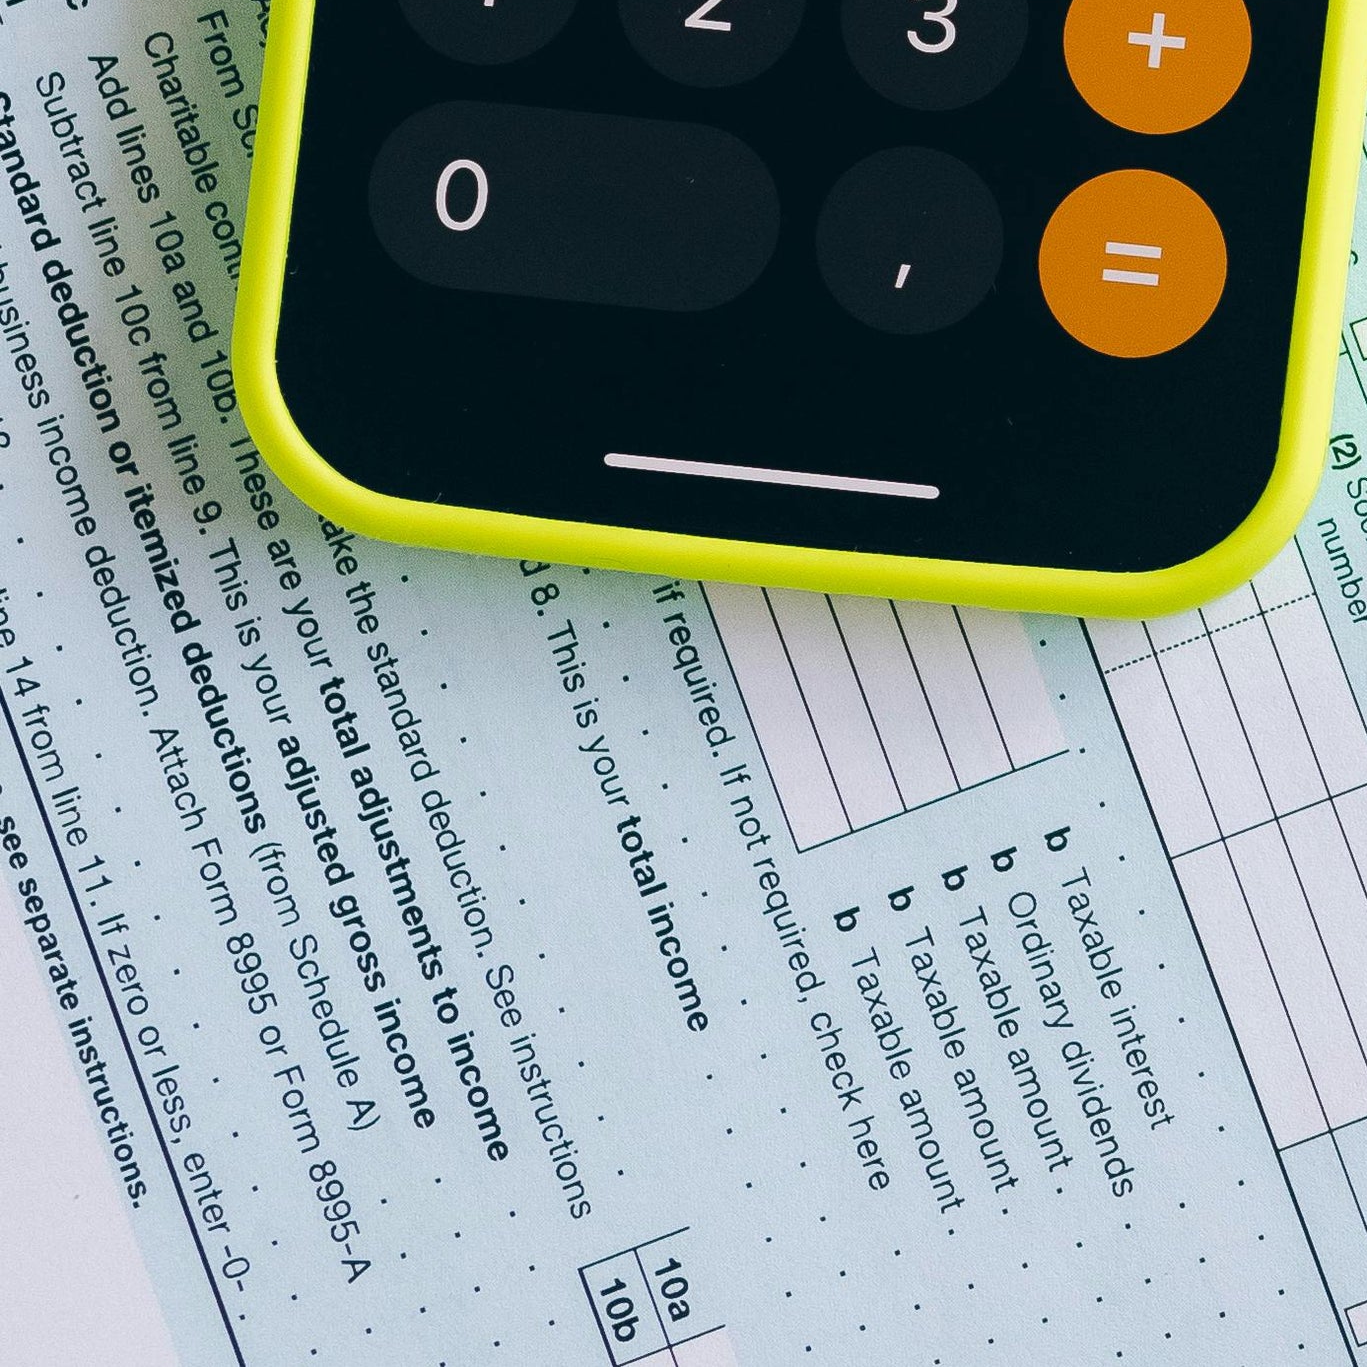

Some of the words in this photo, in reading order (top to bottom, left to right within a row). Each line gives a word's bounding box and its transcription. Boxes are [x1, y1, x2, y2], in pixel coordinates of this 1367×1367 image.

[35, 71, 107, 213] Subtract
[435, 159, 489, 232] 0
[86, 215, 126, 277] line
[114, 283, 151, 347] 10c
[137, 350, 182, 431] from
[166, 433, 205, 495] line
[1327, 433, 1362, 470] (2)
[192, 499, 222, 535] 9.
[208, 535, 248, 611] This
[233, 615, 262, 647] is
[546, 618, 586, 692] This
[239, 652, 291, 724] your
[571, 697, 599, 728] is
[577, 734, 630, 805] your
[276, 735, 355, 886] adjusted
[615, 814, 668, 897] total
[345, 580, 379, 634] the
[366, 641, 441, 782] standard
[420, 789, 493, 958] deduction.
[484, 963, 522, 1028] See
[509, 1032, 591, 1219] instructions
[328, 894, 386, 992] gross
[646, 900, 708, 1032] income
[1043, 824, 1071, 852] b
[1060, 865, 1123, 999] Taxable
[1109, 1004, 1175, 1131] interest
[17, 877, 78, 1010] separate
[67, 1015, 147, 1209] instructions.
[989, 845, 1017, 873] b
[1007, 890, 1074, 1028] Ordinary
[1060, 1040, 1135, 1197] dividends
[373, 996, 435, 1129] income
[599, 1277, 639, 1343] 10b
[653, 1256, 690, 1322] 10a
